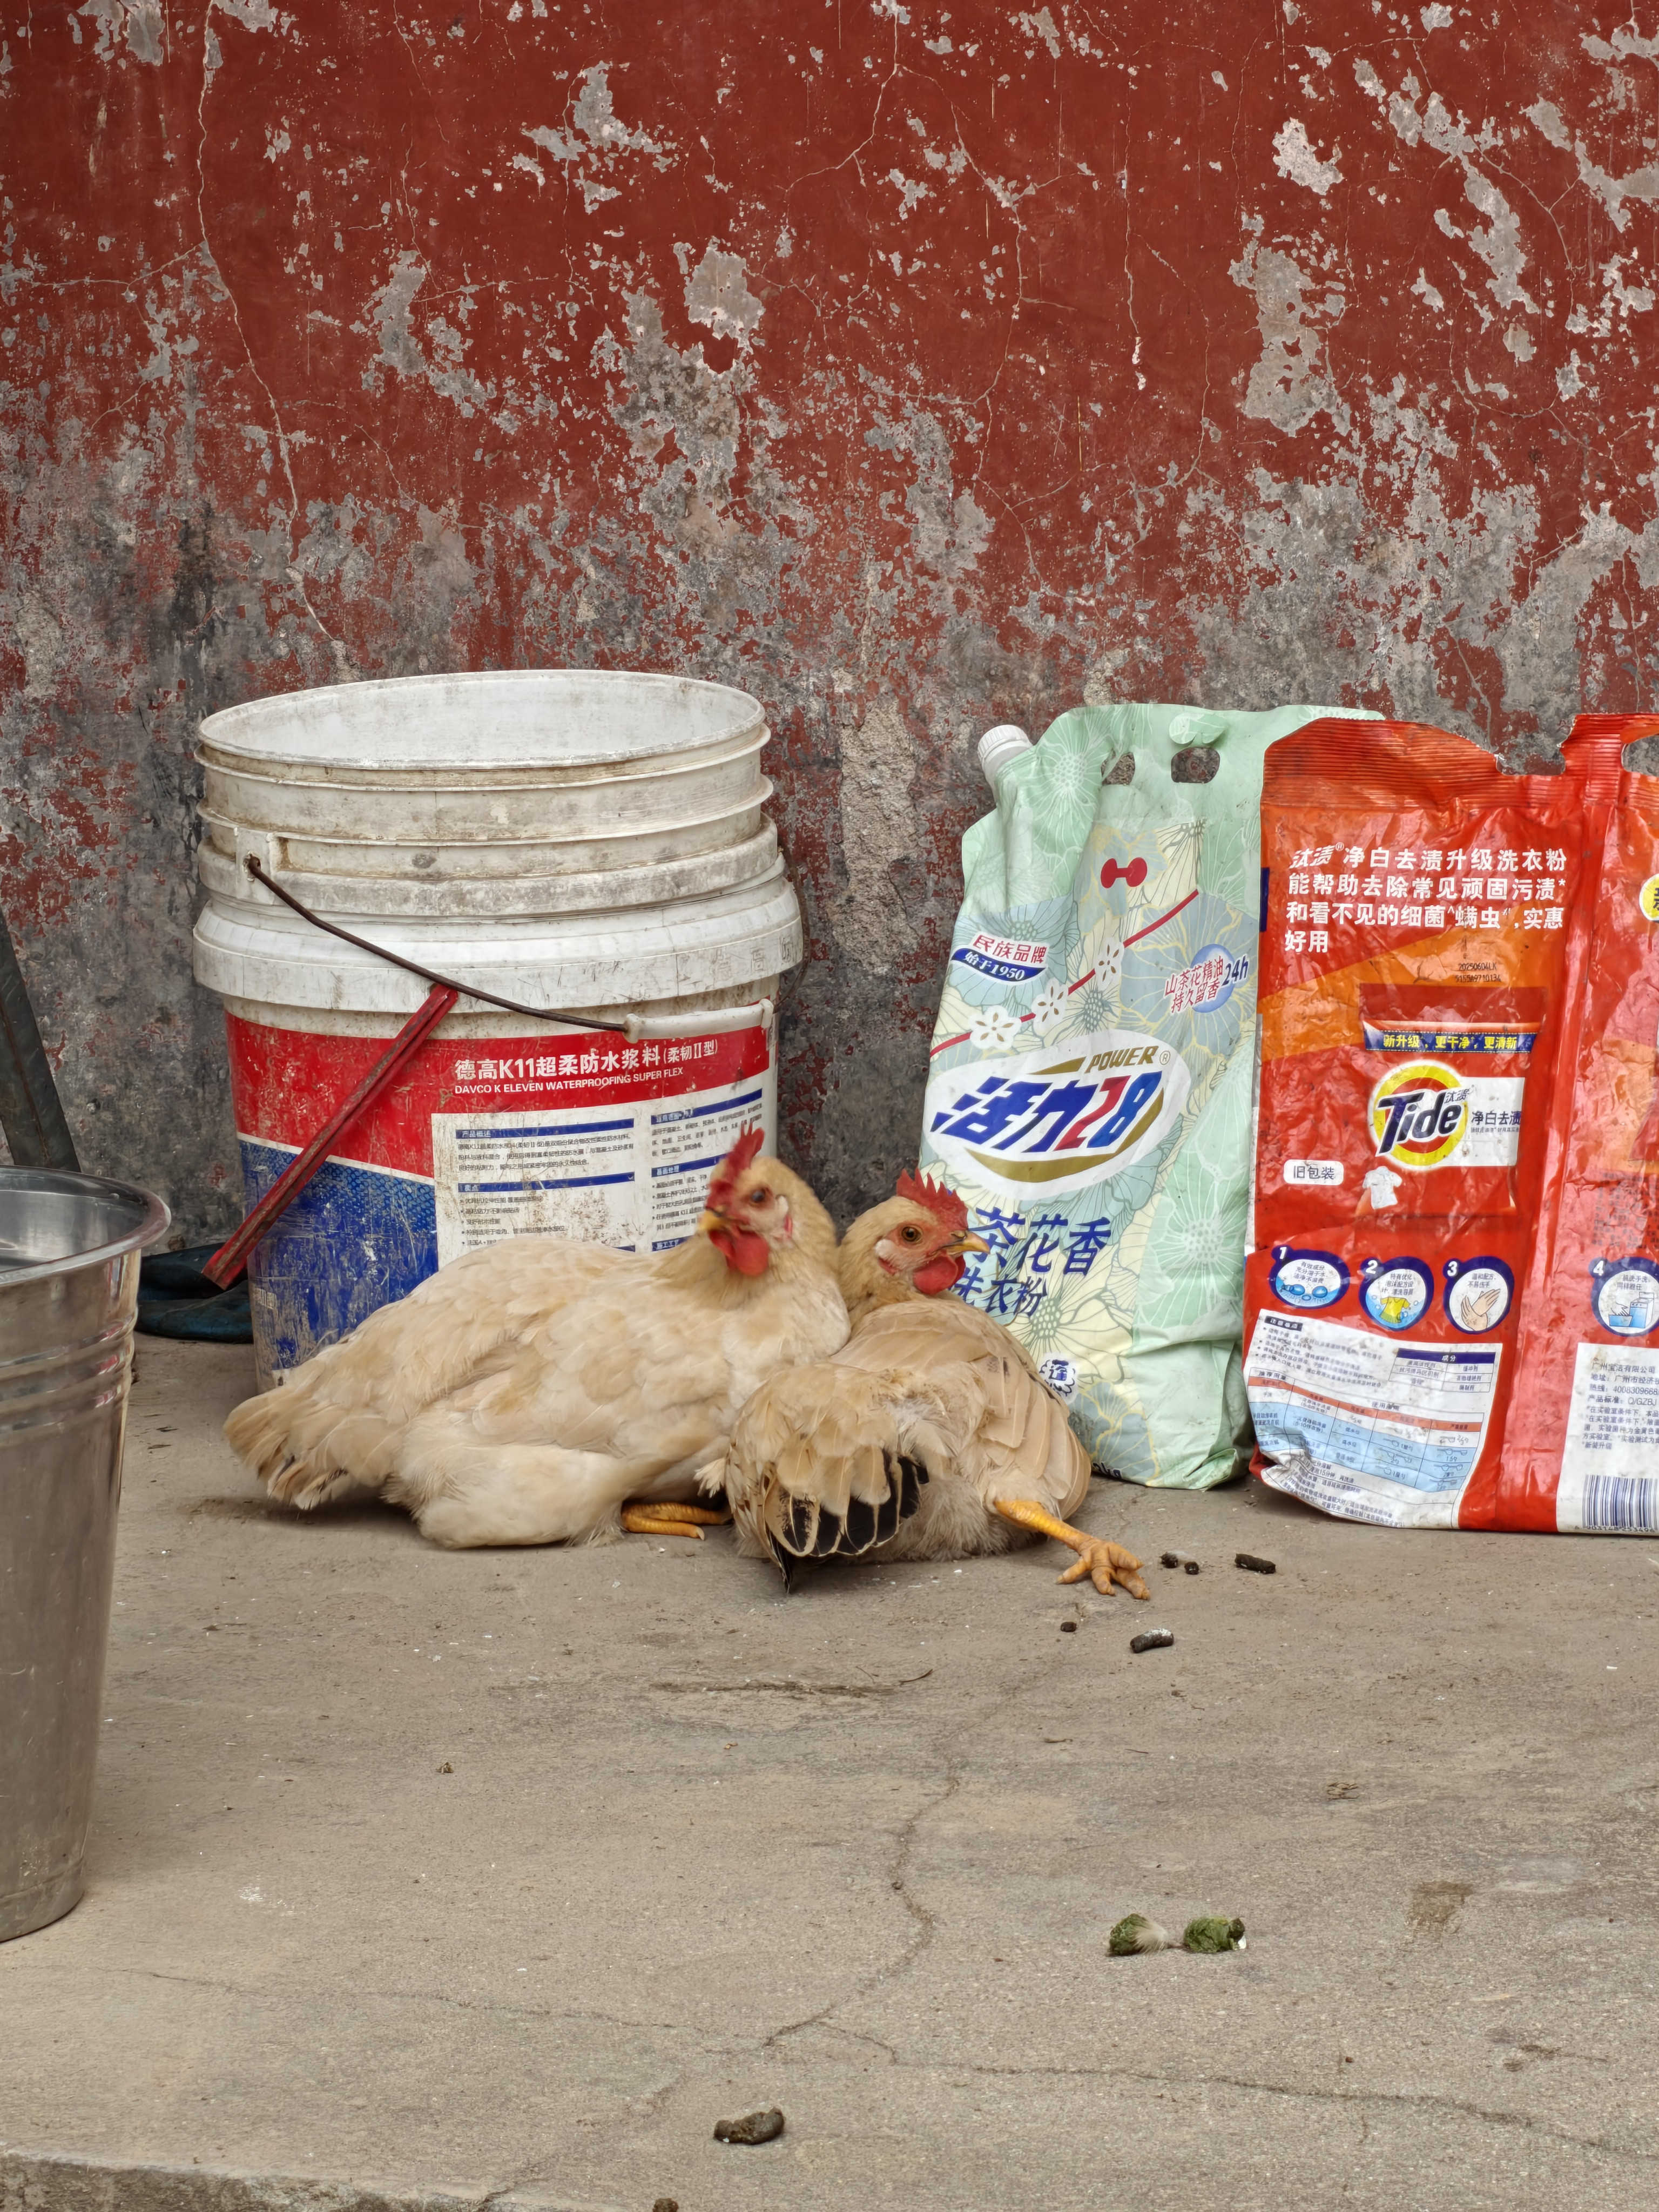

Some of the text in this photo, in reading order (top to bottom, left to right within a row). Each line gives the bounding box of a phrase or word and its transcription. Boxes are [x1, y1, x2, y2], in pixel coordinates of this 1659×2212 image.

[973, 934, 1047, 964] 民族品牌
[1285, 929, 1328, 953] 好用
[963, 951, 1025, 980] 始于1950
[1165, 955, 1223, 996] 山茶花精油
[1222, 955, 1249, 987] 24h
[1171, 977, 1220, 1013] 持久留香
[455, 1067, 684, 1095] DAVCO K ELEVEN WATERPROOFING SUPER FLEX
[930, 1070, 1163, 1154] 活力28
[1377, 1091, 1462, 1154] Tide
[1471, 1110, 1522, 1125] 净白去渍
[1293, 1165, 1334, 1180] 旧包装
[1279, 1246, 1287, 1260] 1
[1365, 1260, 1378, 1274] 2
[1447, 1261, 1458, 1277] 3
[1593, 1260, 1604, 1276] 4
[1592, 1361, 1656, 1374] 广州宝洁有限公司
